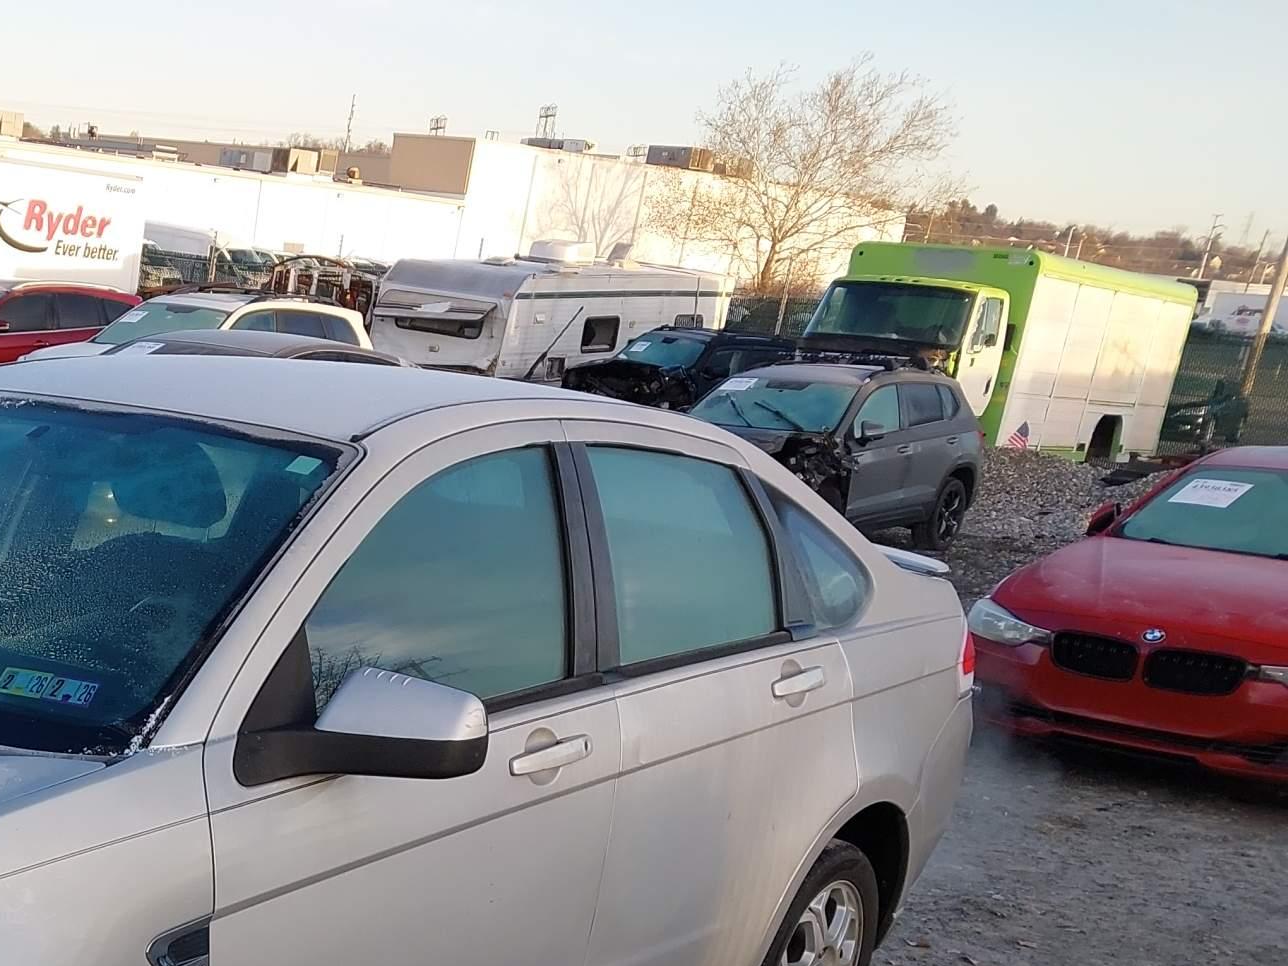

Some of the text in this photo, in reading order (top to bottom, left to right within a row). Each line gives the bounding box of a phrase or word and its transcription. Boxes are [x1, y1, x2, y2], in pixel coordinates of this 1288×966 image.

[23, 199, 112, 242] Ryder
[54, 239, 120, 262] Ever better.
